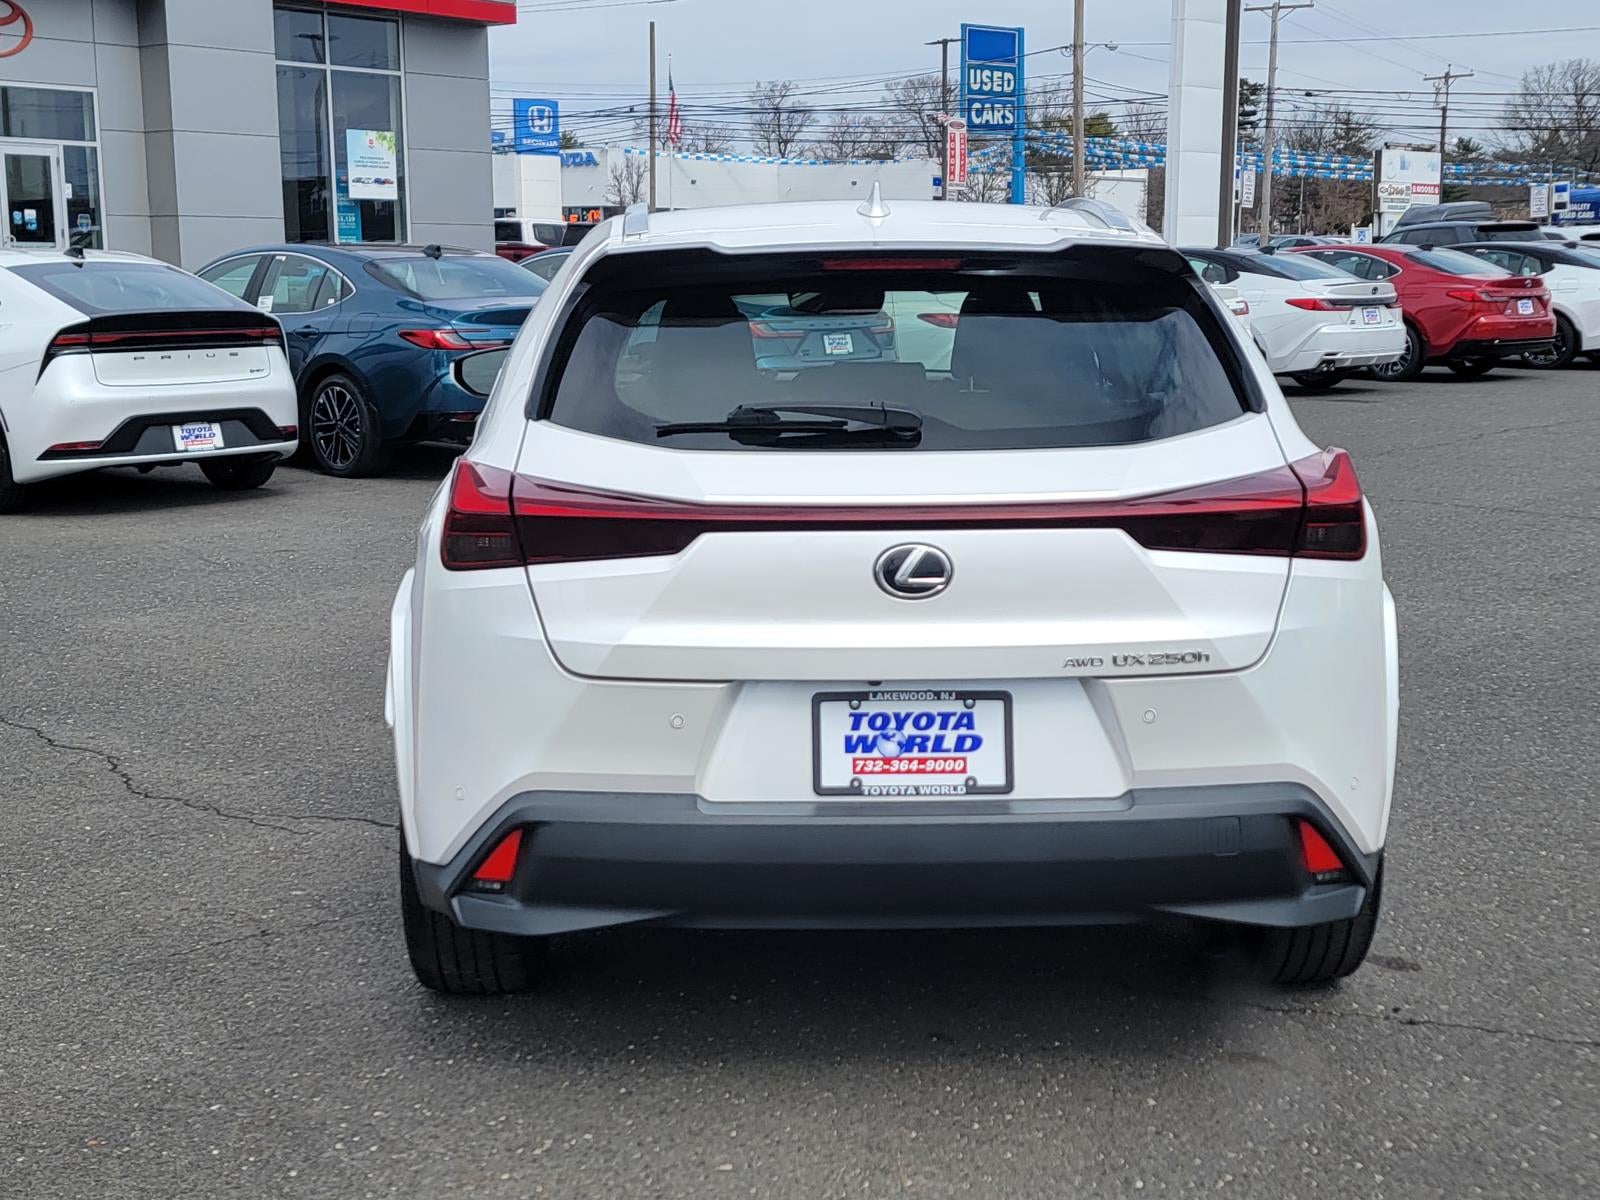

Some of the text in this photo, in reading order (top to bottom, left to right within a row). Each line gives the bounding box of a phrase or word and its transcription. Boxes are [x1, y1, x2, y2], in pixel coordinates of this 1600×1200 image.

[969, 68, 1015, 93] USED
[971, 102, 1014, 125] CARS
[133, 352, 239, 361] PRIUS
[180, 426, 213, 435] TOYOTA
[180, 432, 216, 441] WORLD
[1062, 651, 1210, 668] AWD UX 250h
[940, 692, 956, 700] NJ
[848, 711, 975, 731] TOYOTA
[844, 732, 983, 755] WORLD
[854, 759, 965, 773] 732-364-9000
[862, 785, 967, 796] TOYOTA WORLD
